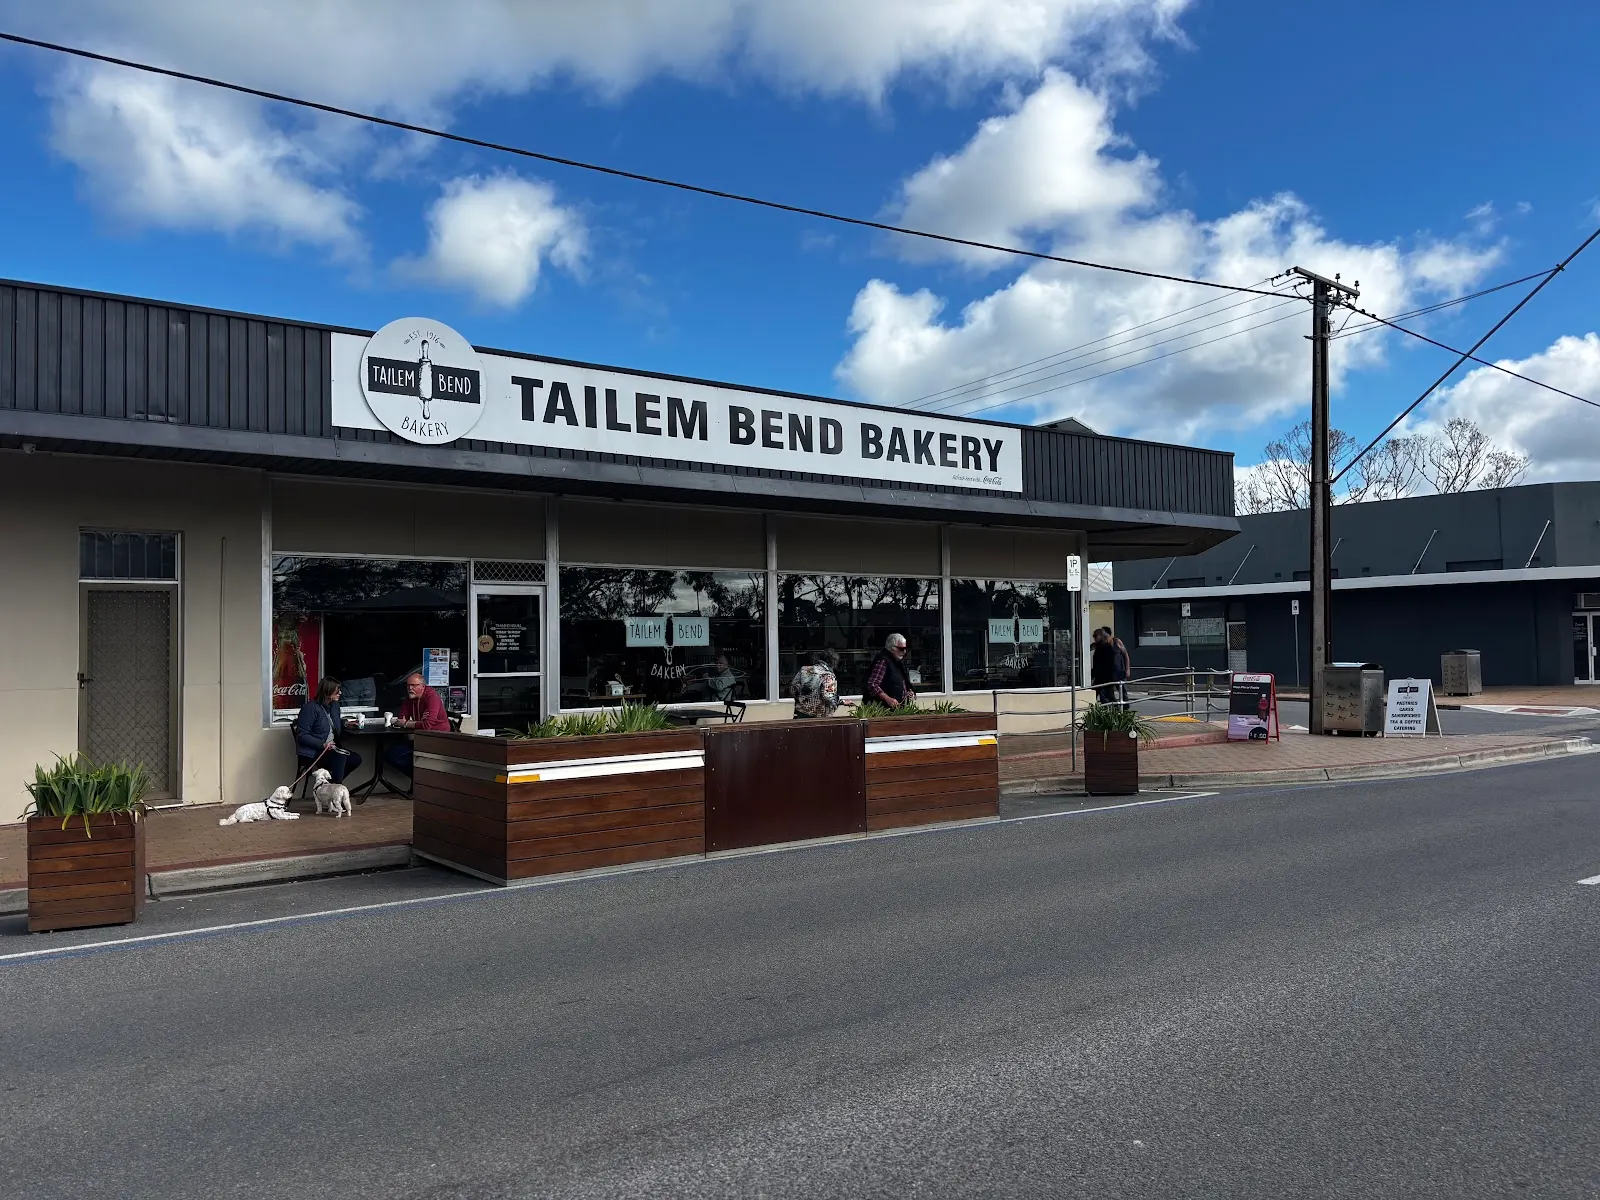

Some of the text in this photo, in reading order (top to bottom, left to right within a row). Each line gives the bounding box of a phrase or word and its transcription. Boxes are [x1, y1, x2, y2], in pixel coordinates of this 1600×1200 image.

[426, 330, 440, 344] 1916
[373, 366, 472, 395] TAILEM BEND
[401, 416, 449, 437] BAKERY
[511, 375, 1003, 472] TAILEM BEND BAKERY
[1070, 559, 1078, 568] 1P
[630, 624, 702, 639] TAILEM BEND
[991, 624, 1039, 637] TAILEM BEND
[1005, 656, 1028, 669] BAKERY
[650, 663, 686, 680] BAKERY
